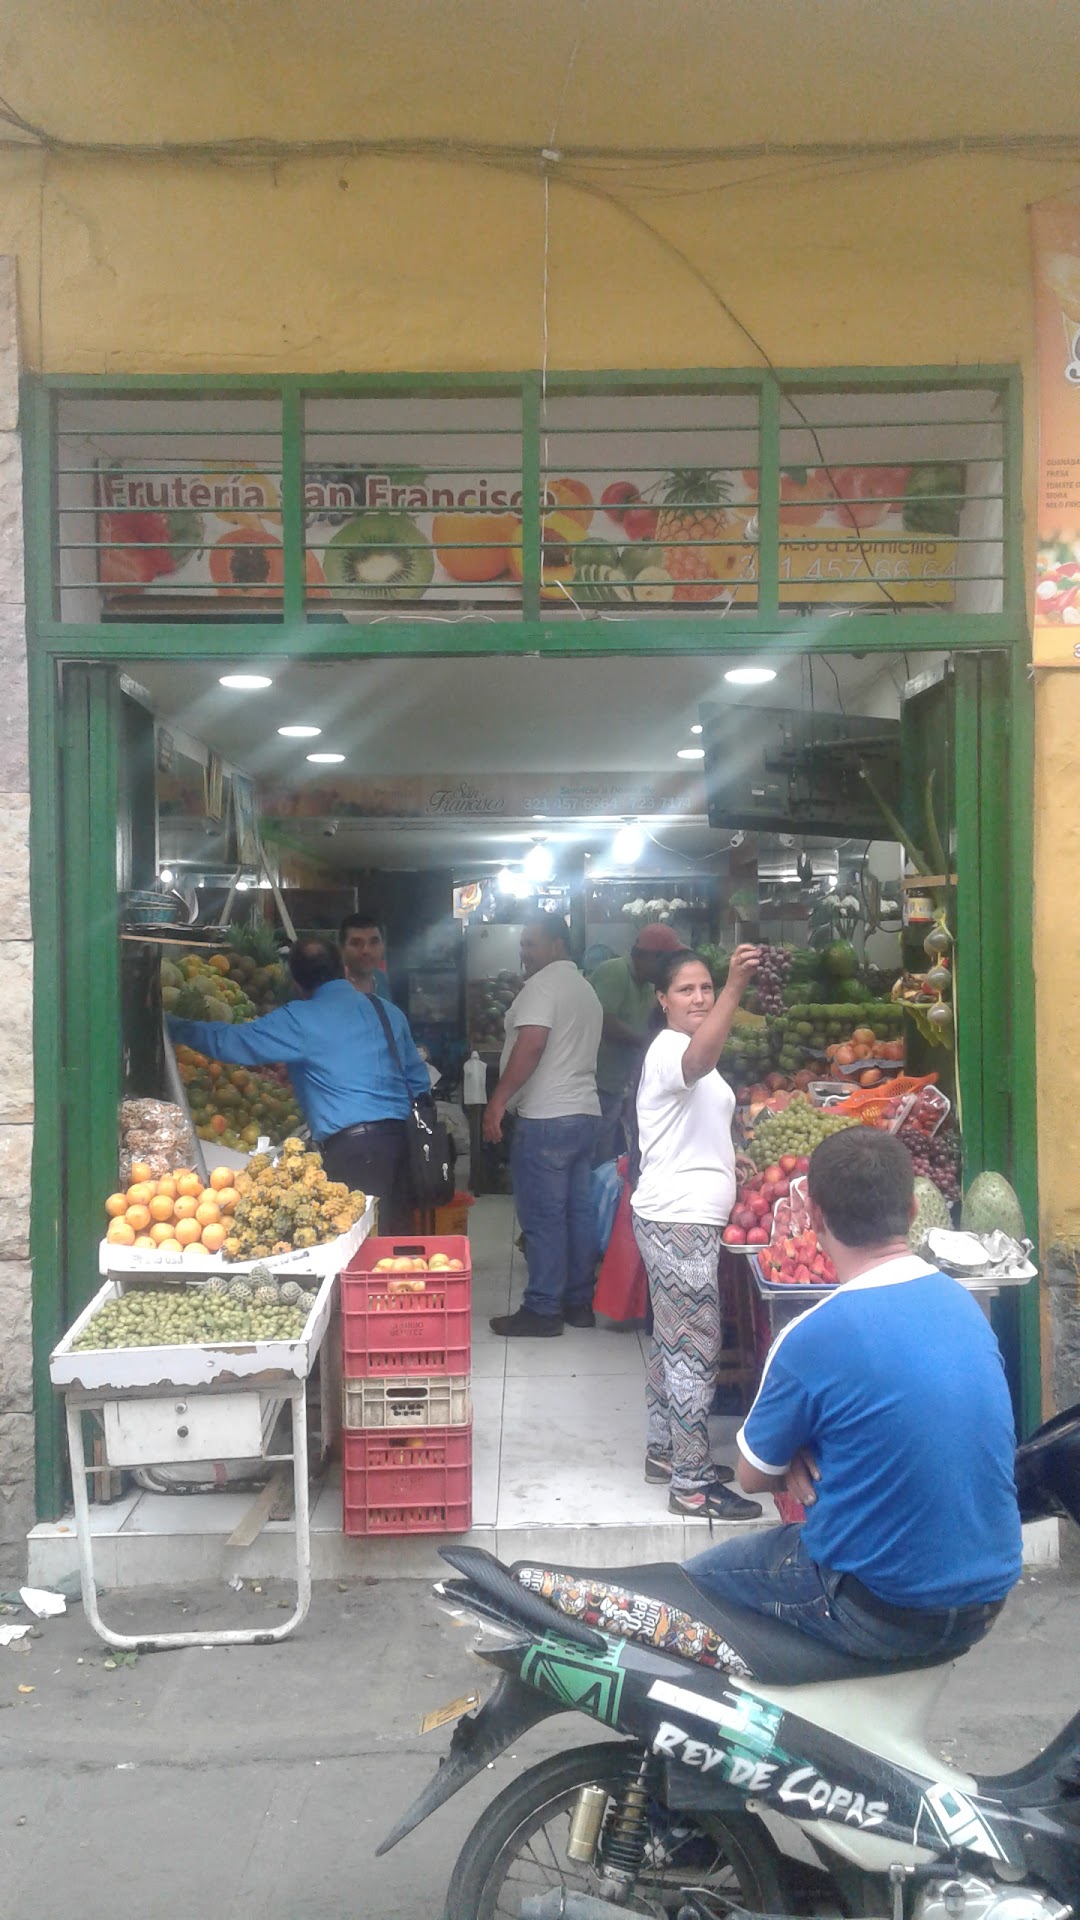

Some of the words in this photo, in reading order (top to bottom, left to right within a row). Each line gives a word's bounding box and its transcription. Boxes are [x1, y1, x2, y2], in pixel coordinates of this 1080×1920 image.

[102, 474, 265, 508] Frutería
[280, 480, 352, 509] an
[728, 1755, 779, 1791] DE
